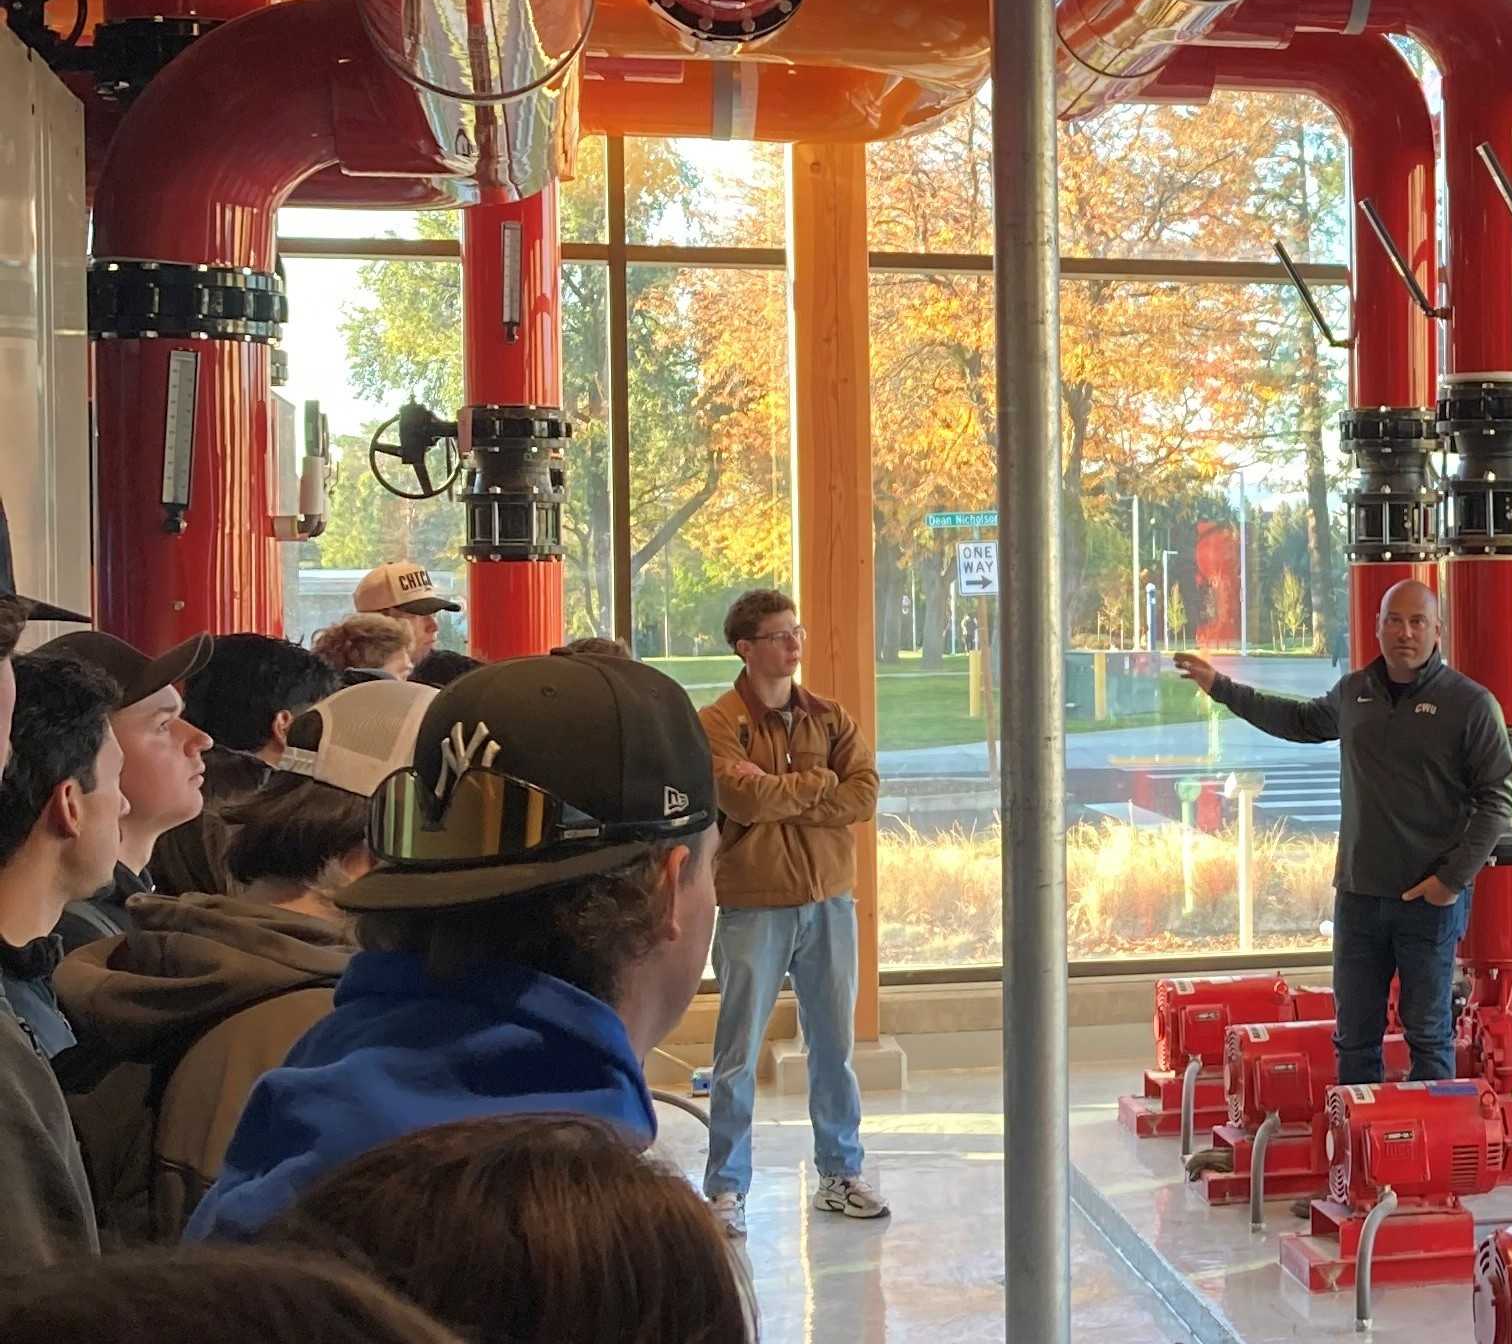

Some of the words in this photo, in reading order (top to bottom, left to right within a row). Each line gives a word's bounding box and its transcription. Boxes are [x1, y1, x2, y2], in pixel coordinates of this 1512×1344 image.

[963, 546, 992, 559] ONE
[964, 561, 994, 574] WAY
[1415, 703, 1437, 715] CWU
